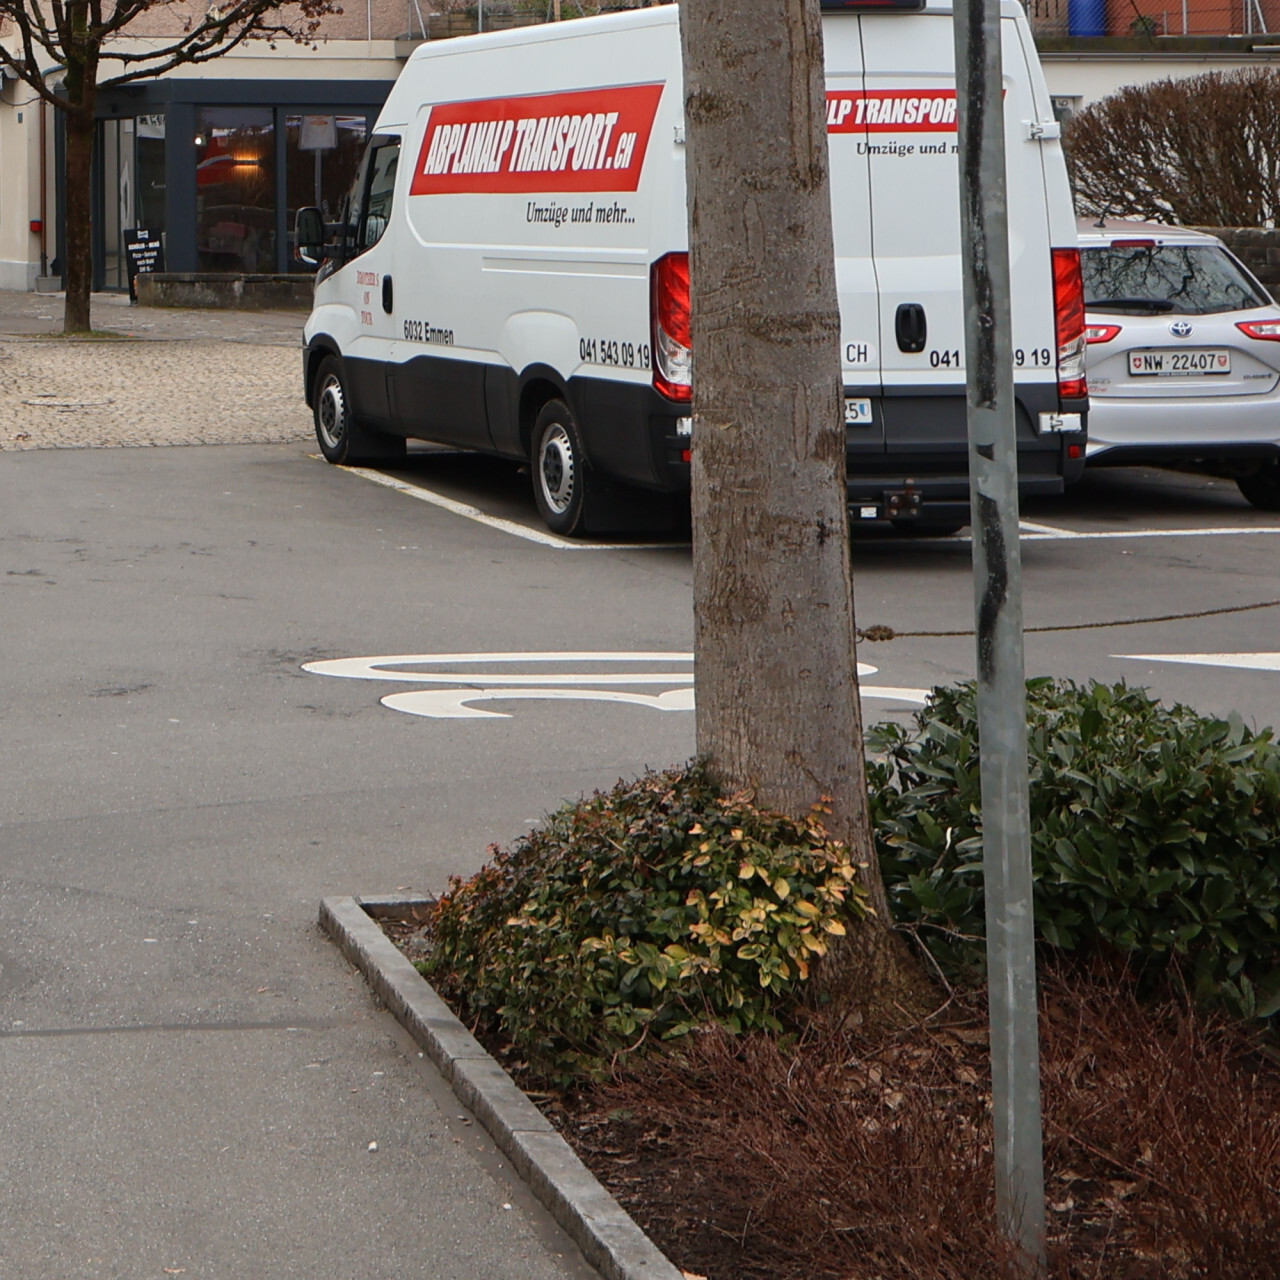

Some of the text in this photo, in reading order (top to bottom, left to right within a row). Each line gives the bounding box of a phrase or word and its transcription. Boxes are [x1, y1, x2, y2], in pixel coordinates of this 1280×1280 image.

[854, 97, 958, 125] TRANSPOR
[423, 119, 515, 175] ABPLANALP
[856, 141, 915, 157] Umzüge
[919, 141, 947, 155] und
[526, 201, 636, 228] Umzüge und mehr...
[403, 319, 454, 345] 6032 Emmen
[579, 337, 650, 368] 041 543 09 19
[846, 344, 868, 363] CH
[929, 350, 960, 368] 041
[1030, 348, 1051, 366] 19
